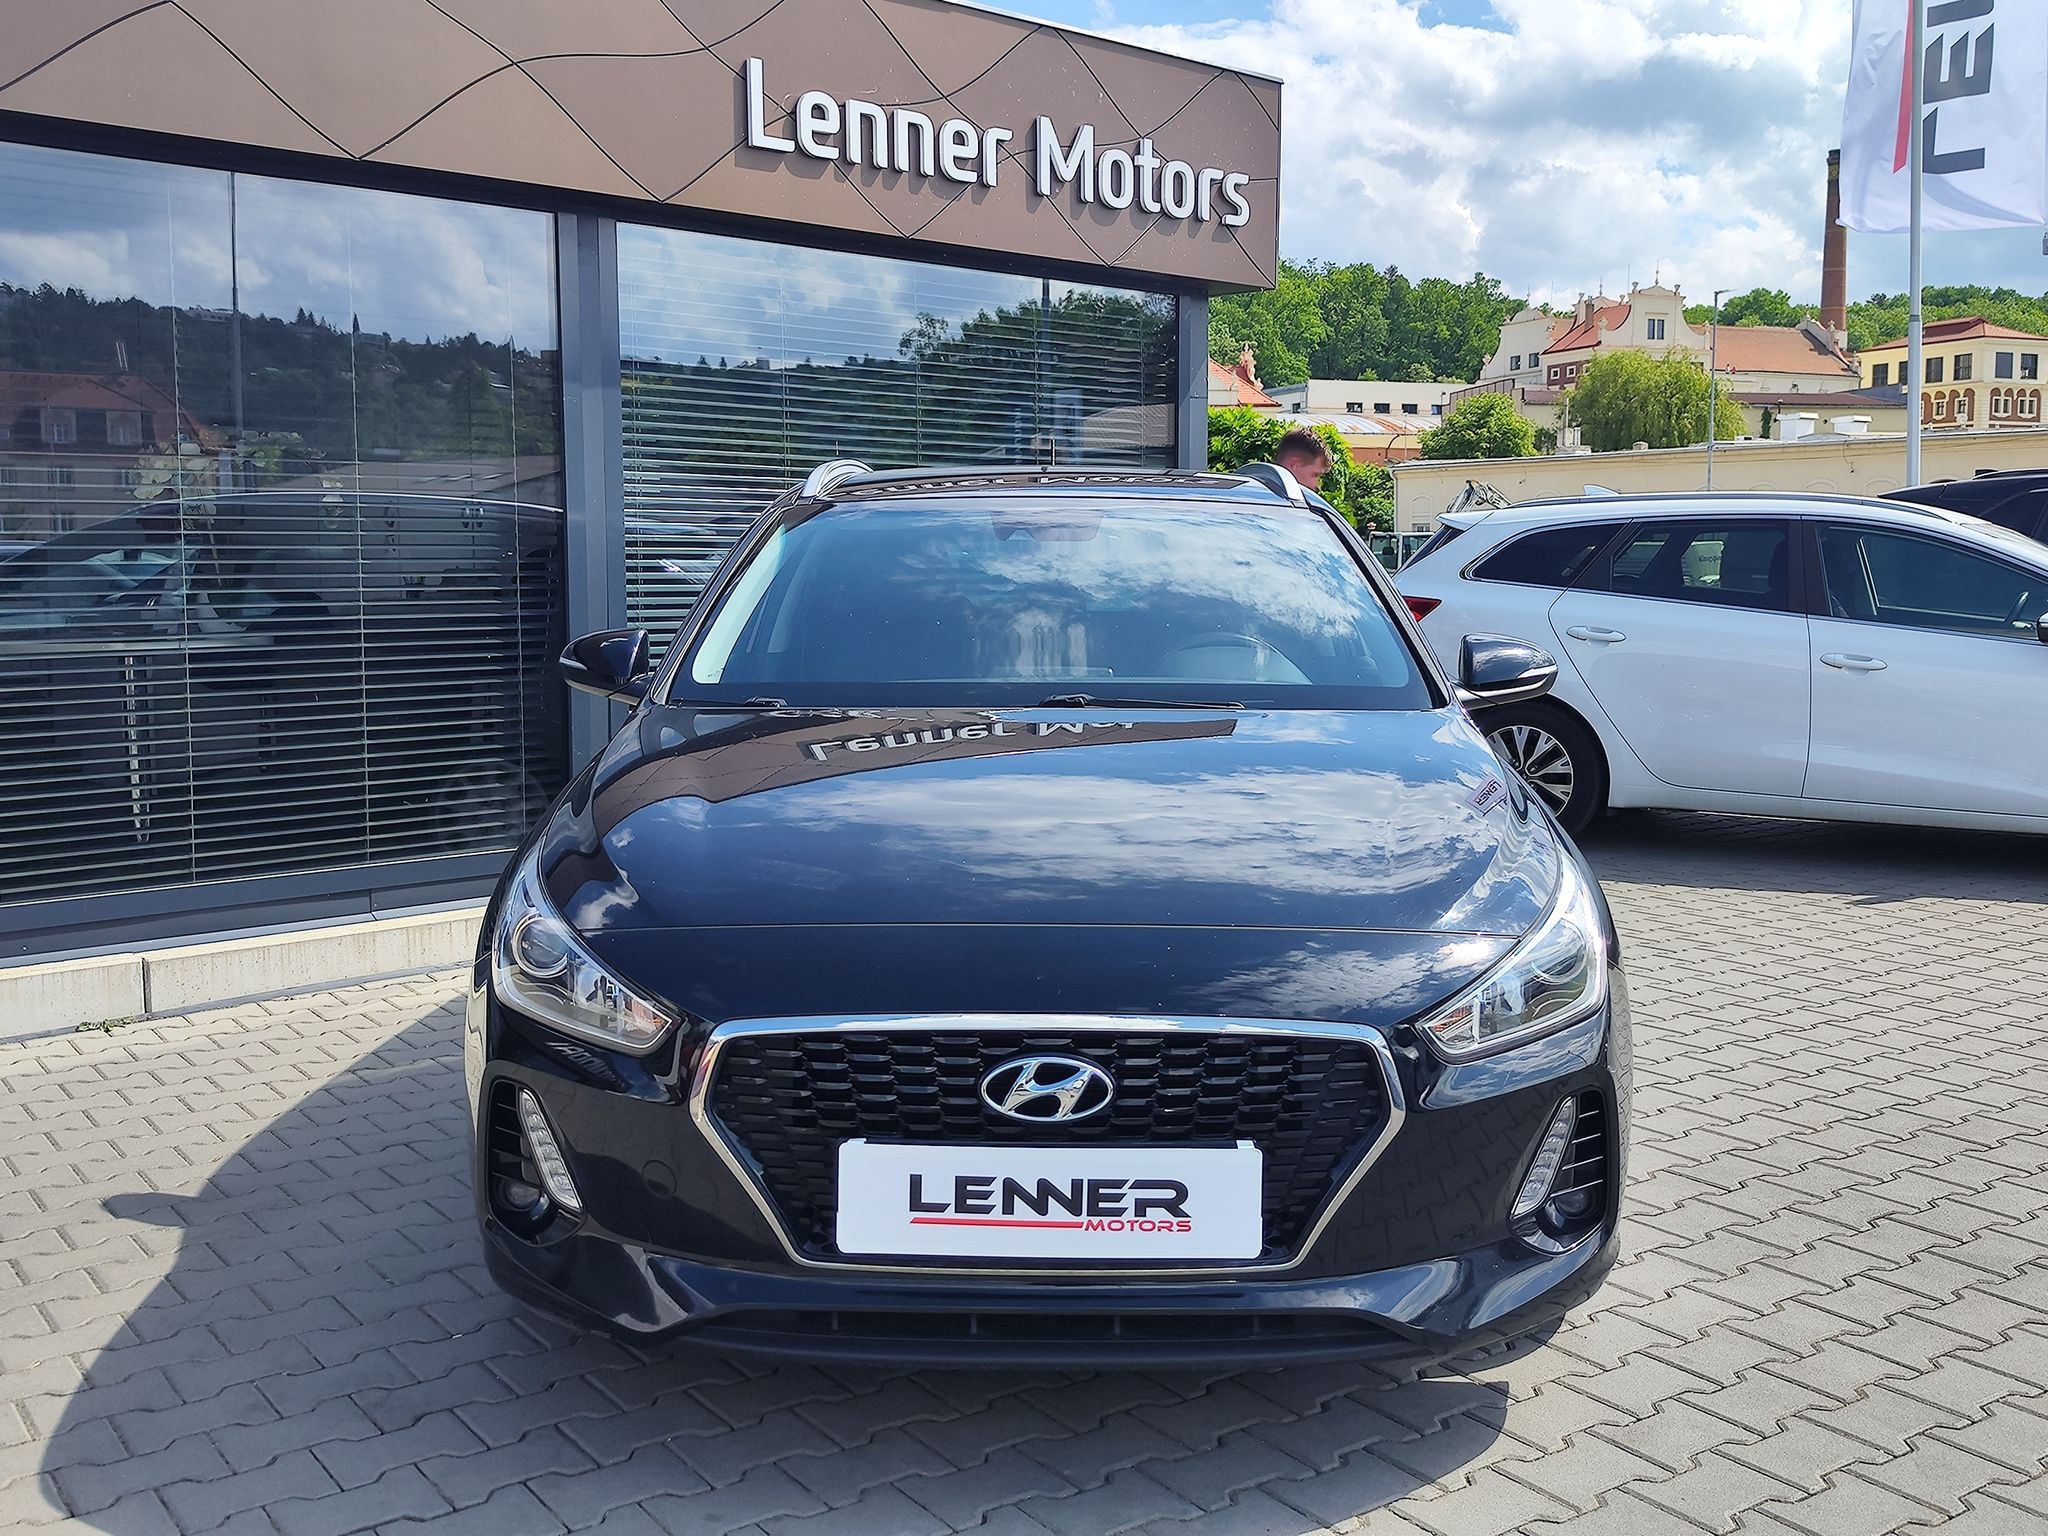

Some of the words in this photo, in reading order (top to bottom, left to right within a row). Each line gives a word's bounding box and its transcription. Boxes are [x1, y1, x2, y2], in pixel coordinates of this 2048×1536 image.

[746, 57, 1013, 188] Lenner
[1036, 115, 1250, 226] Motors
[909, 1174, 1192, 1218] LENNER
[1084, 1218, 1192, 1232] MOTORS
